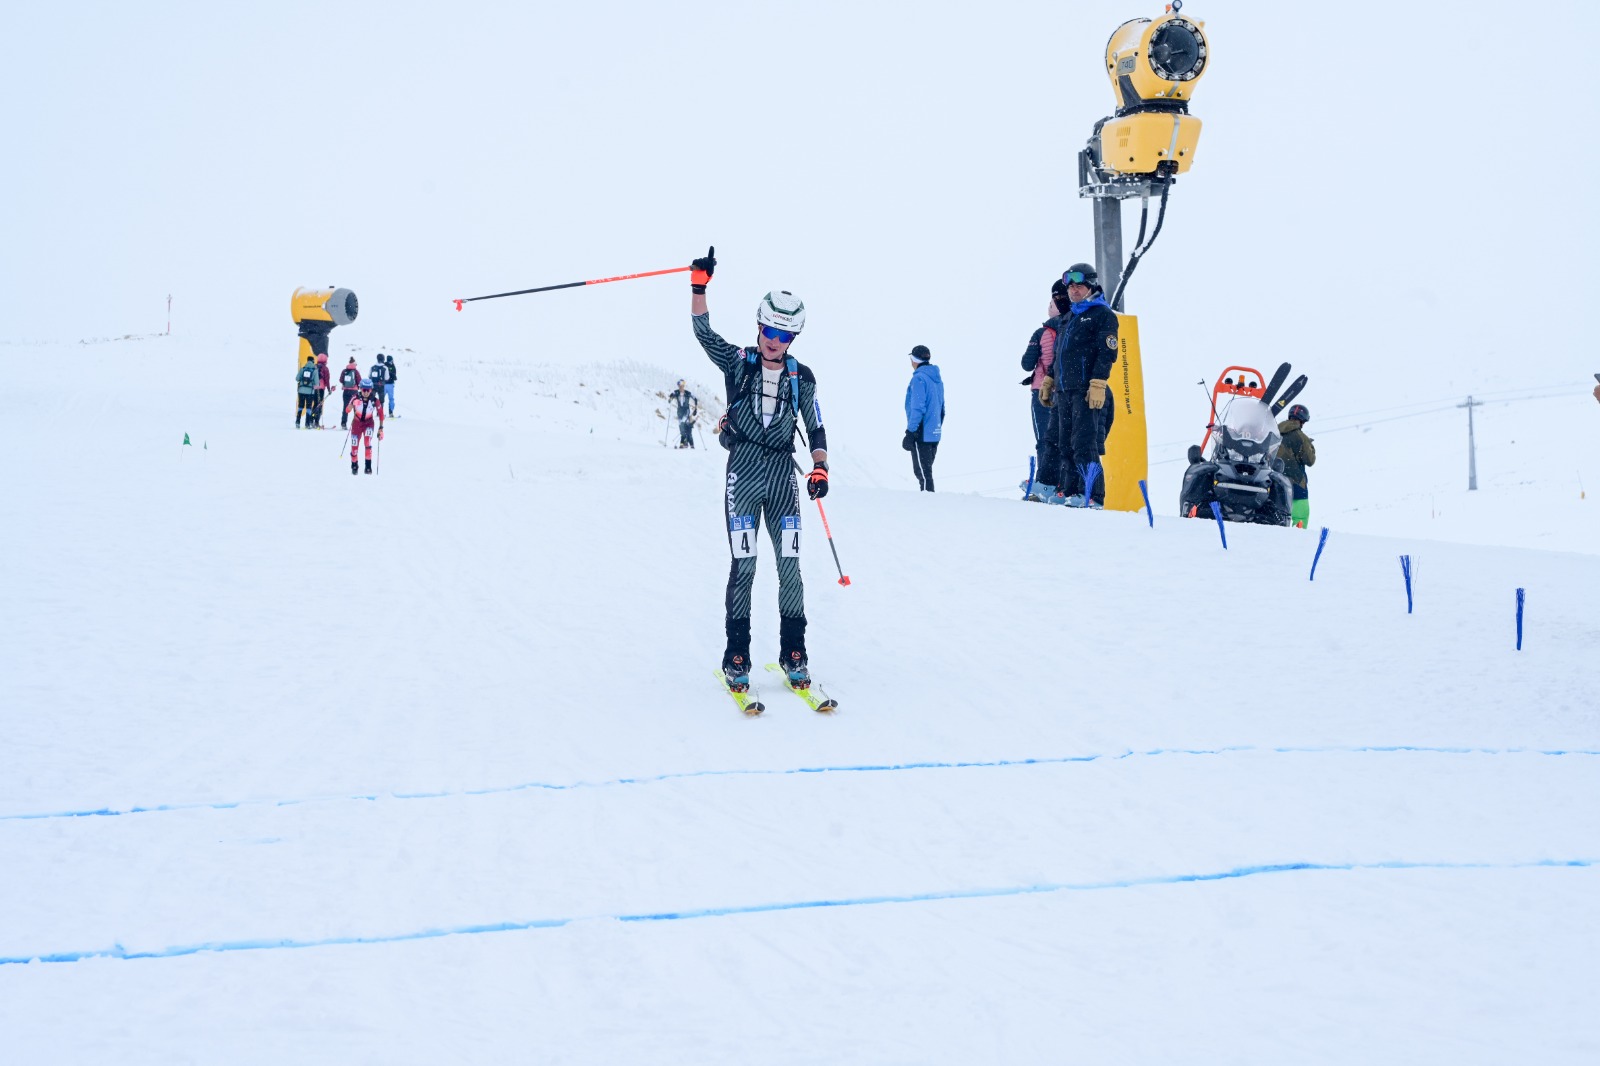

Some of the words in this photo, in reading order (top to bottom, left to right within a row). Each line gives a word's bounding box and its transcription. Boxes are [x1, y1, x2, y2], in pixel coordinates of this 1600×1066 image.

[1121, 338, 1132, 414] www.technoalpin.com
[741, 532, 750, 553] 4
[792, 532, 799, 553] 4
